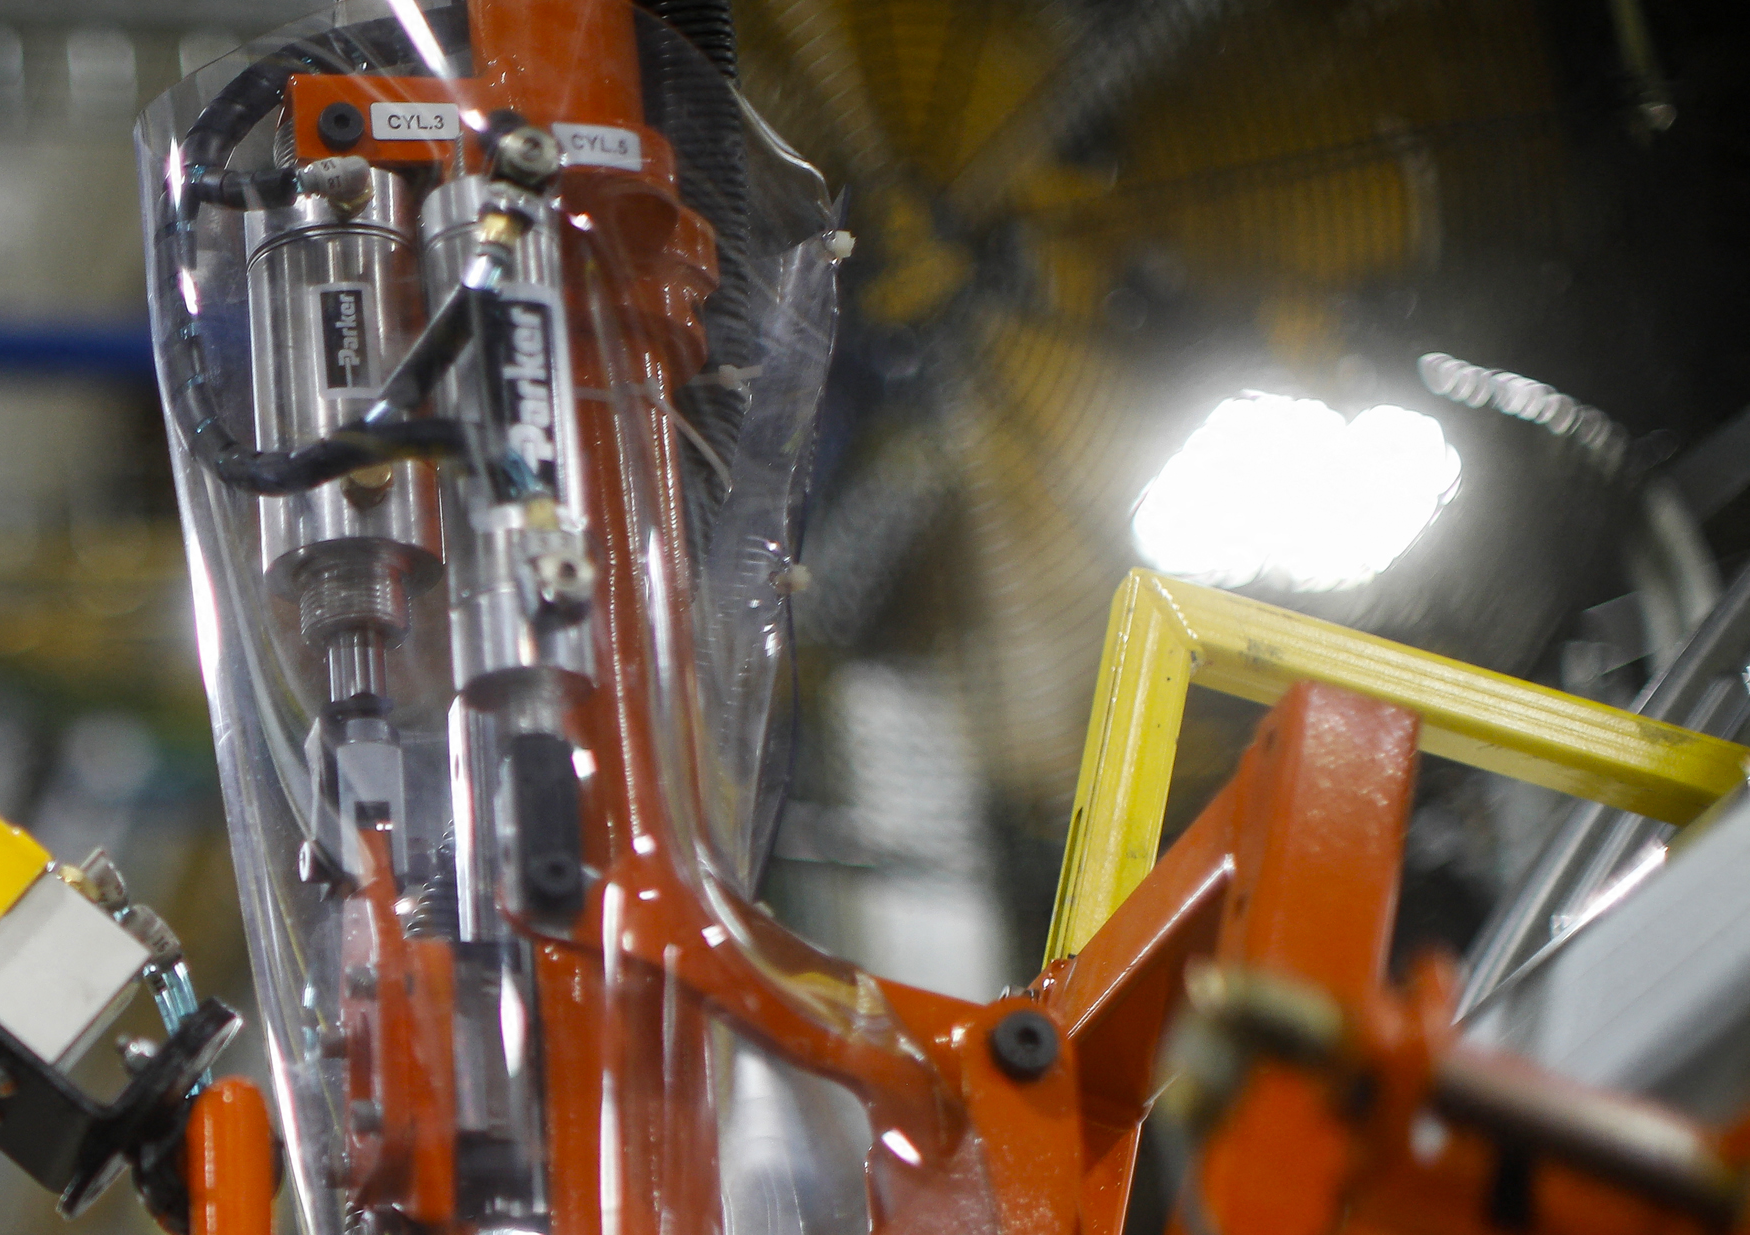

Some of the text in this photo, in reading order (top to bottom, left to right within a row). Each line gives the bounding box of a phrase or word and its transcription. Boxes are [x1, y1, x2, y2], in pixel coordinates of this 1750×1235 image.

[387, 113, 445, 130] CYL.3
[334, 292, 360, 388] Parker
[502, 304, 554, 475] Parker
